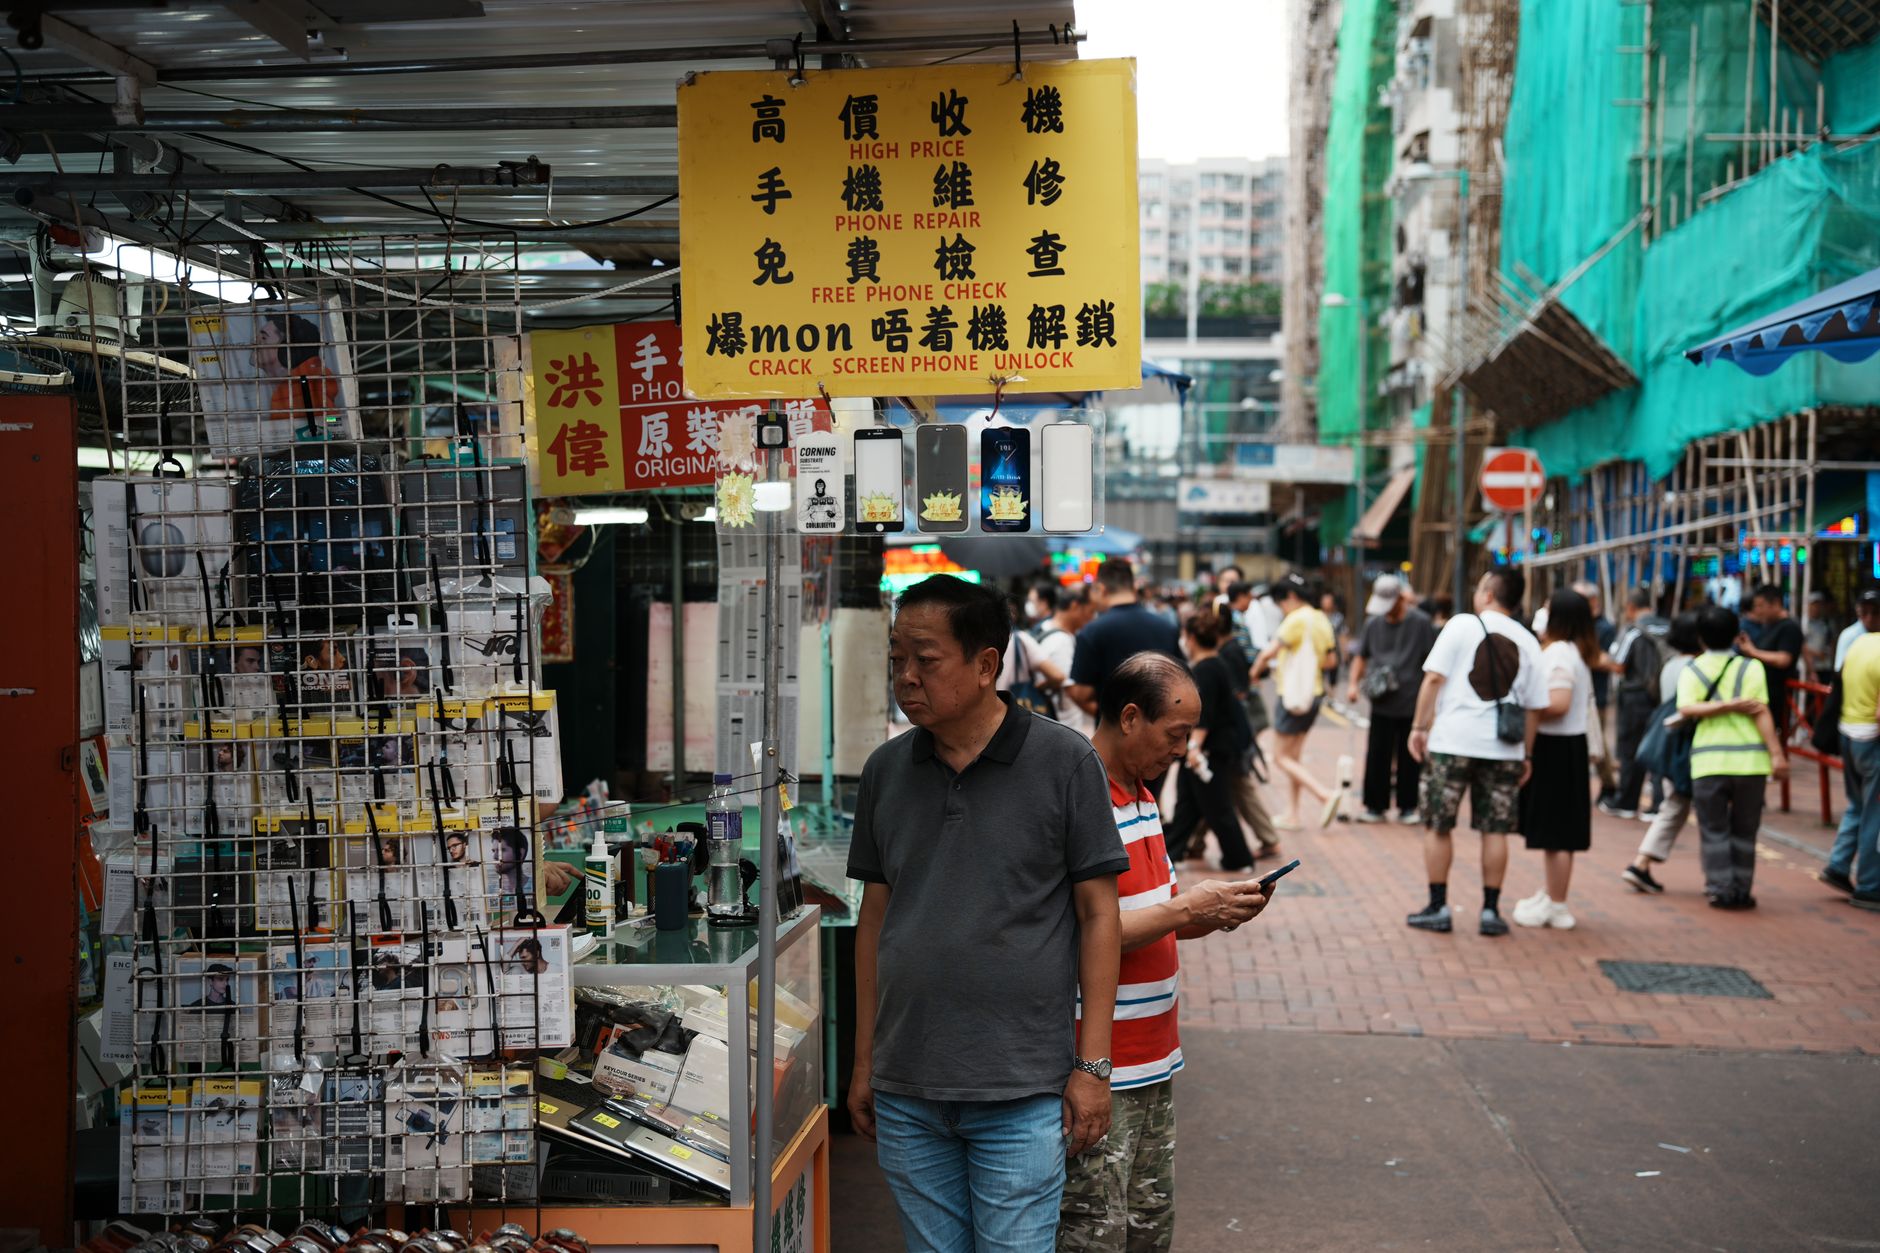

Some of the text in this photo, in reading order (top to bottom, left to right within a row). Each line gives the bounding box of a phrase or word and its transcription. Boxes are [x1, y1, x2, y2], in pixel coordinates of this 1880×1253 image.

[750, 85, 1065, 144] 高價收機
[849, 139, 965, 160] HIGH PRICE
[750, 157, 1067, 216] 手機維修
[834, 211, 982, 232] PHONE REPAIR
[752, 229, 1068, 287] 免費檢查
[811, 281, 1008, 303] FREE PHONE CHECK
[630, 333, 684, 383] 手
[748, 351, 1074, 377] CRACK SCREEN PHONE UNLOCK
[631, 380, 681, 401] PHO
[544, 351, 610, 478] 洪偉
[637, 398, 817, 459] 原裝質
[799, 446, 837, 457] CORNING
[627, 1072, 646, 1083] SERIES
